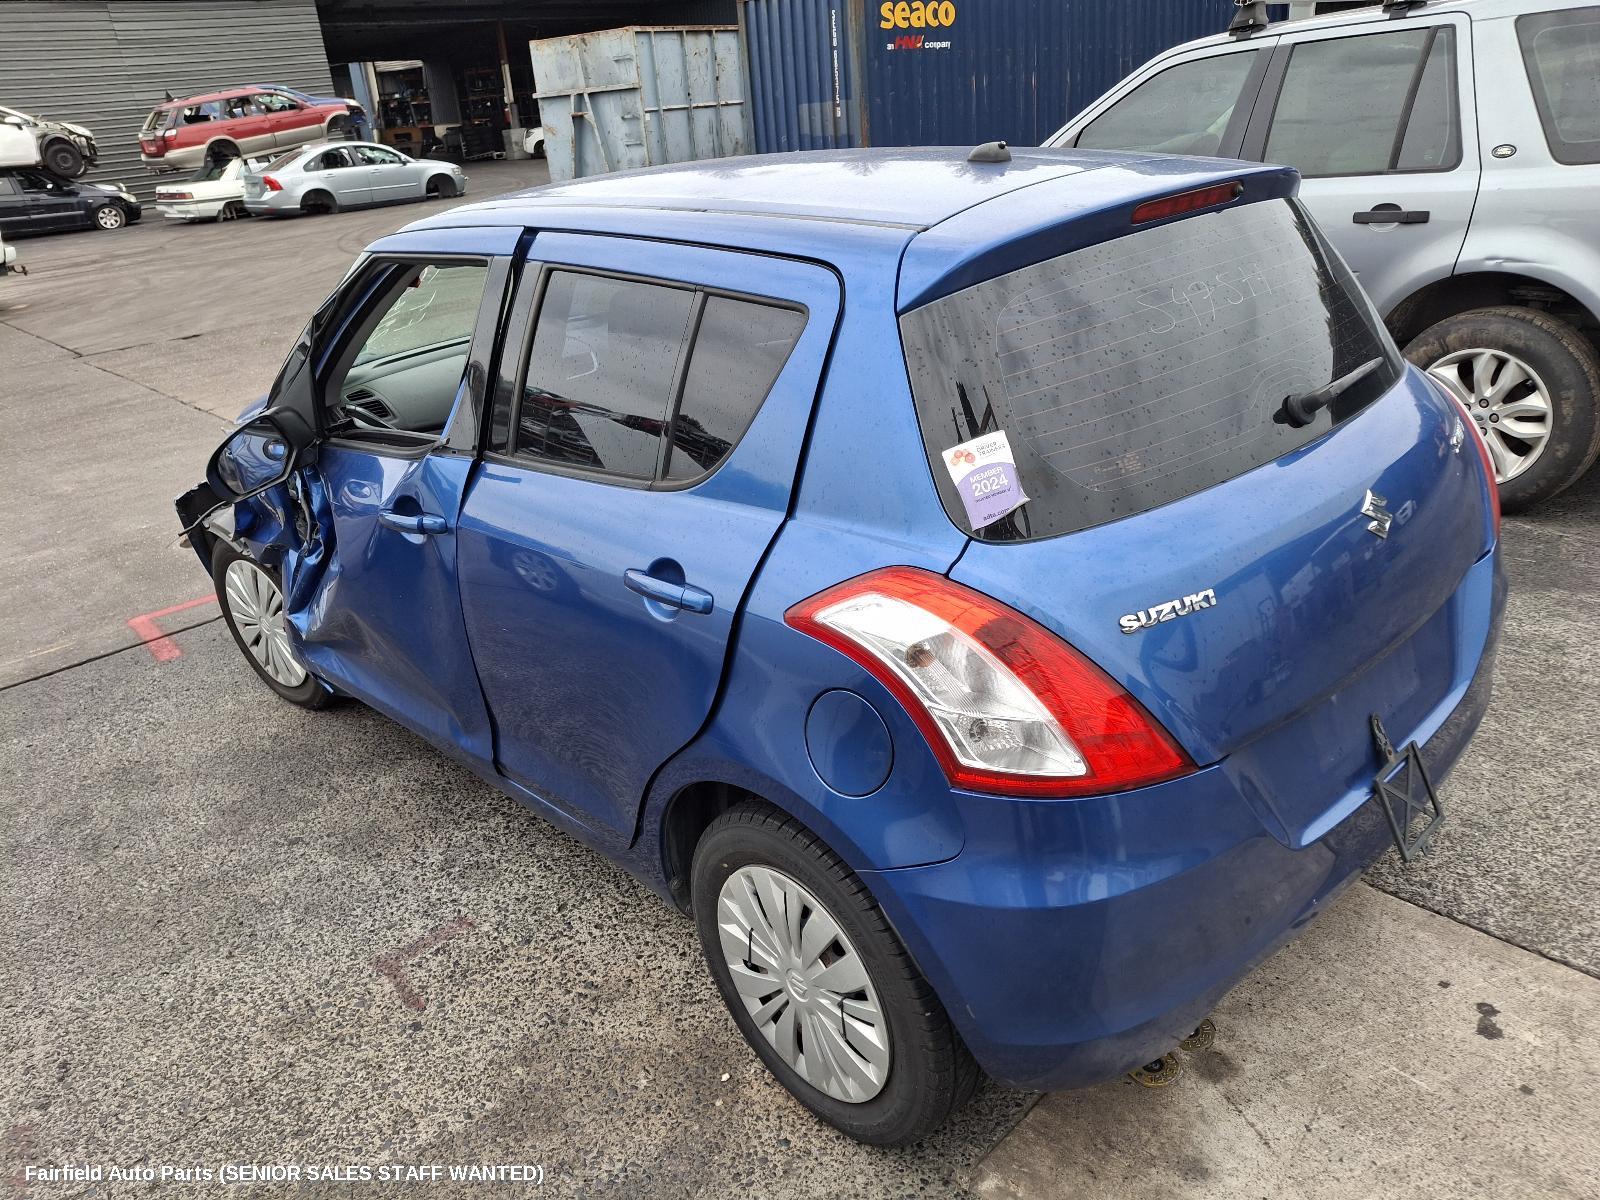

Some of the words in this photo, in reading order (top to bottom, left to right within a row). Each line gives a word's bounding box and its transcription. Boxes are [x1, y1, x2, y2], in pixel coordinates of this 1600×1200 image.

[880, 0, 955, 29] seaco
[969, 466, 1004, 484] MEMBER
[972, 473, 1010, 498] 2024
[1119, 588, 1217, 634] SUZUKI
